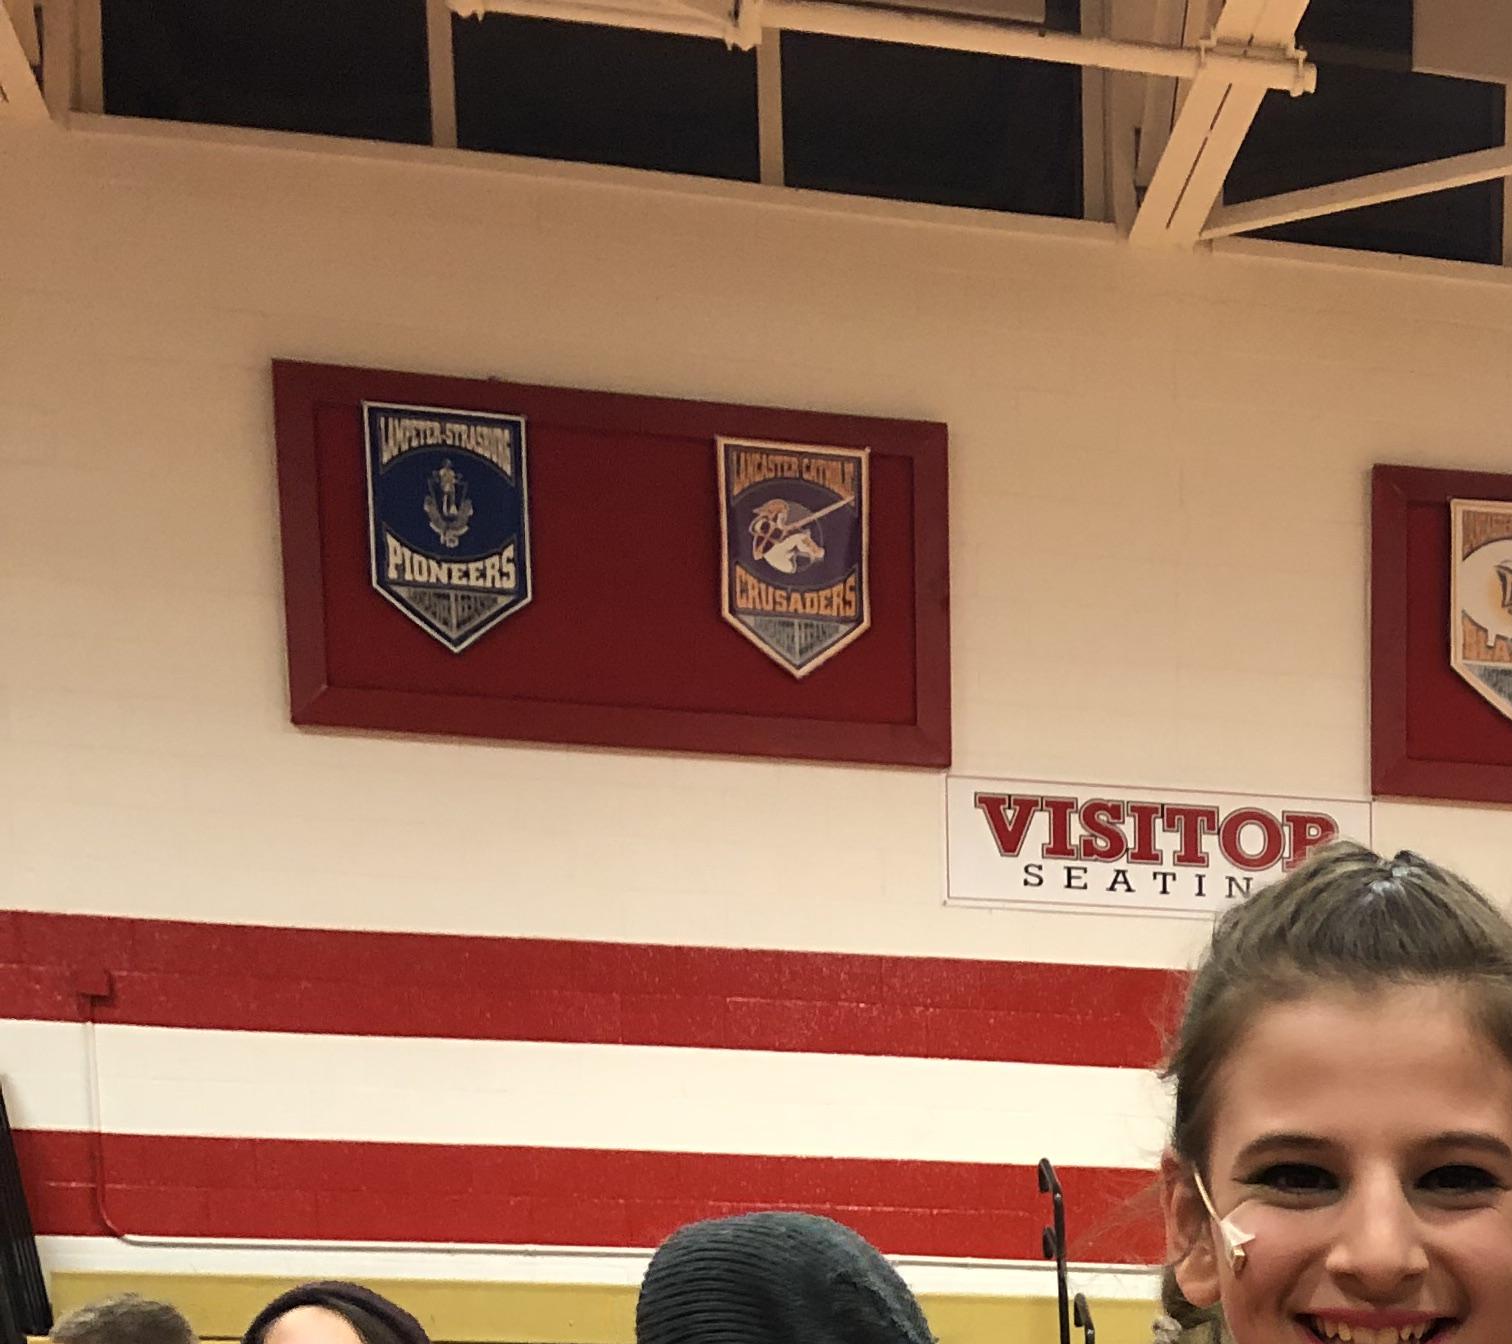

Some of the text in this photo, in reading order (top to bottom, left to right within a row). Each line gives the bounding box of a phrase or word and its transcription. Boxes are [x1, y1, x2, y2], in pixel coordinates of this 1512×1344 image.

[734, 453, 799, 495] LANCASTER
[386, 531, 515, 589] PIONEERS
[734, 565, 857, 617] CRUSADERS
[1023, 863, 1254, 899] SEATIN
